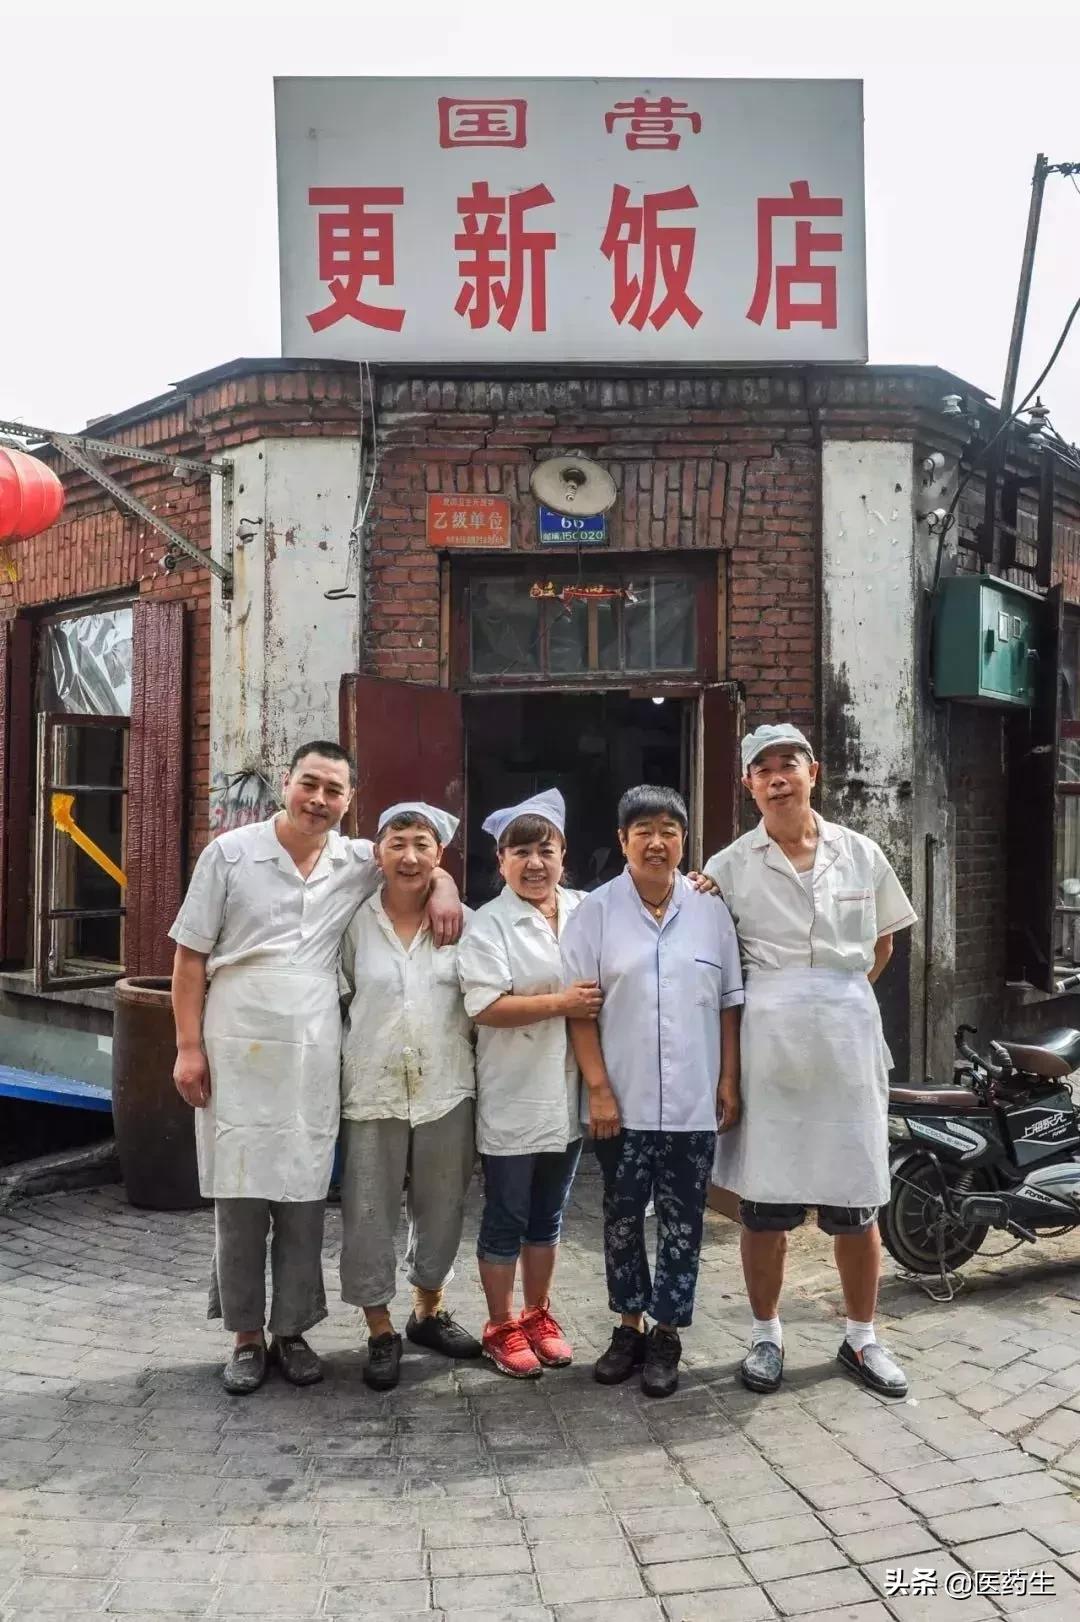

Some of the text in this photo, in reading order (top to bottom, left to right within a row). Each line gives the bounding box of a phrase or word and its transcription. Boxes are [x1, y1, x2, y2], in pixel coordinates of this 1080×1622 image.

[437, 96, 702, 151] 国营
[306, 180, 843, 333] 更新饭店
[432, 511, 504, 529] 乙级单位
